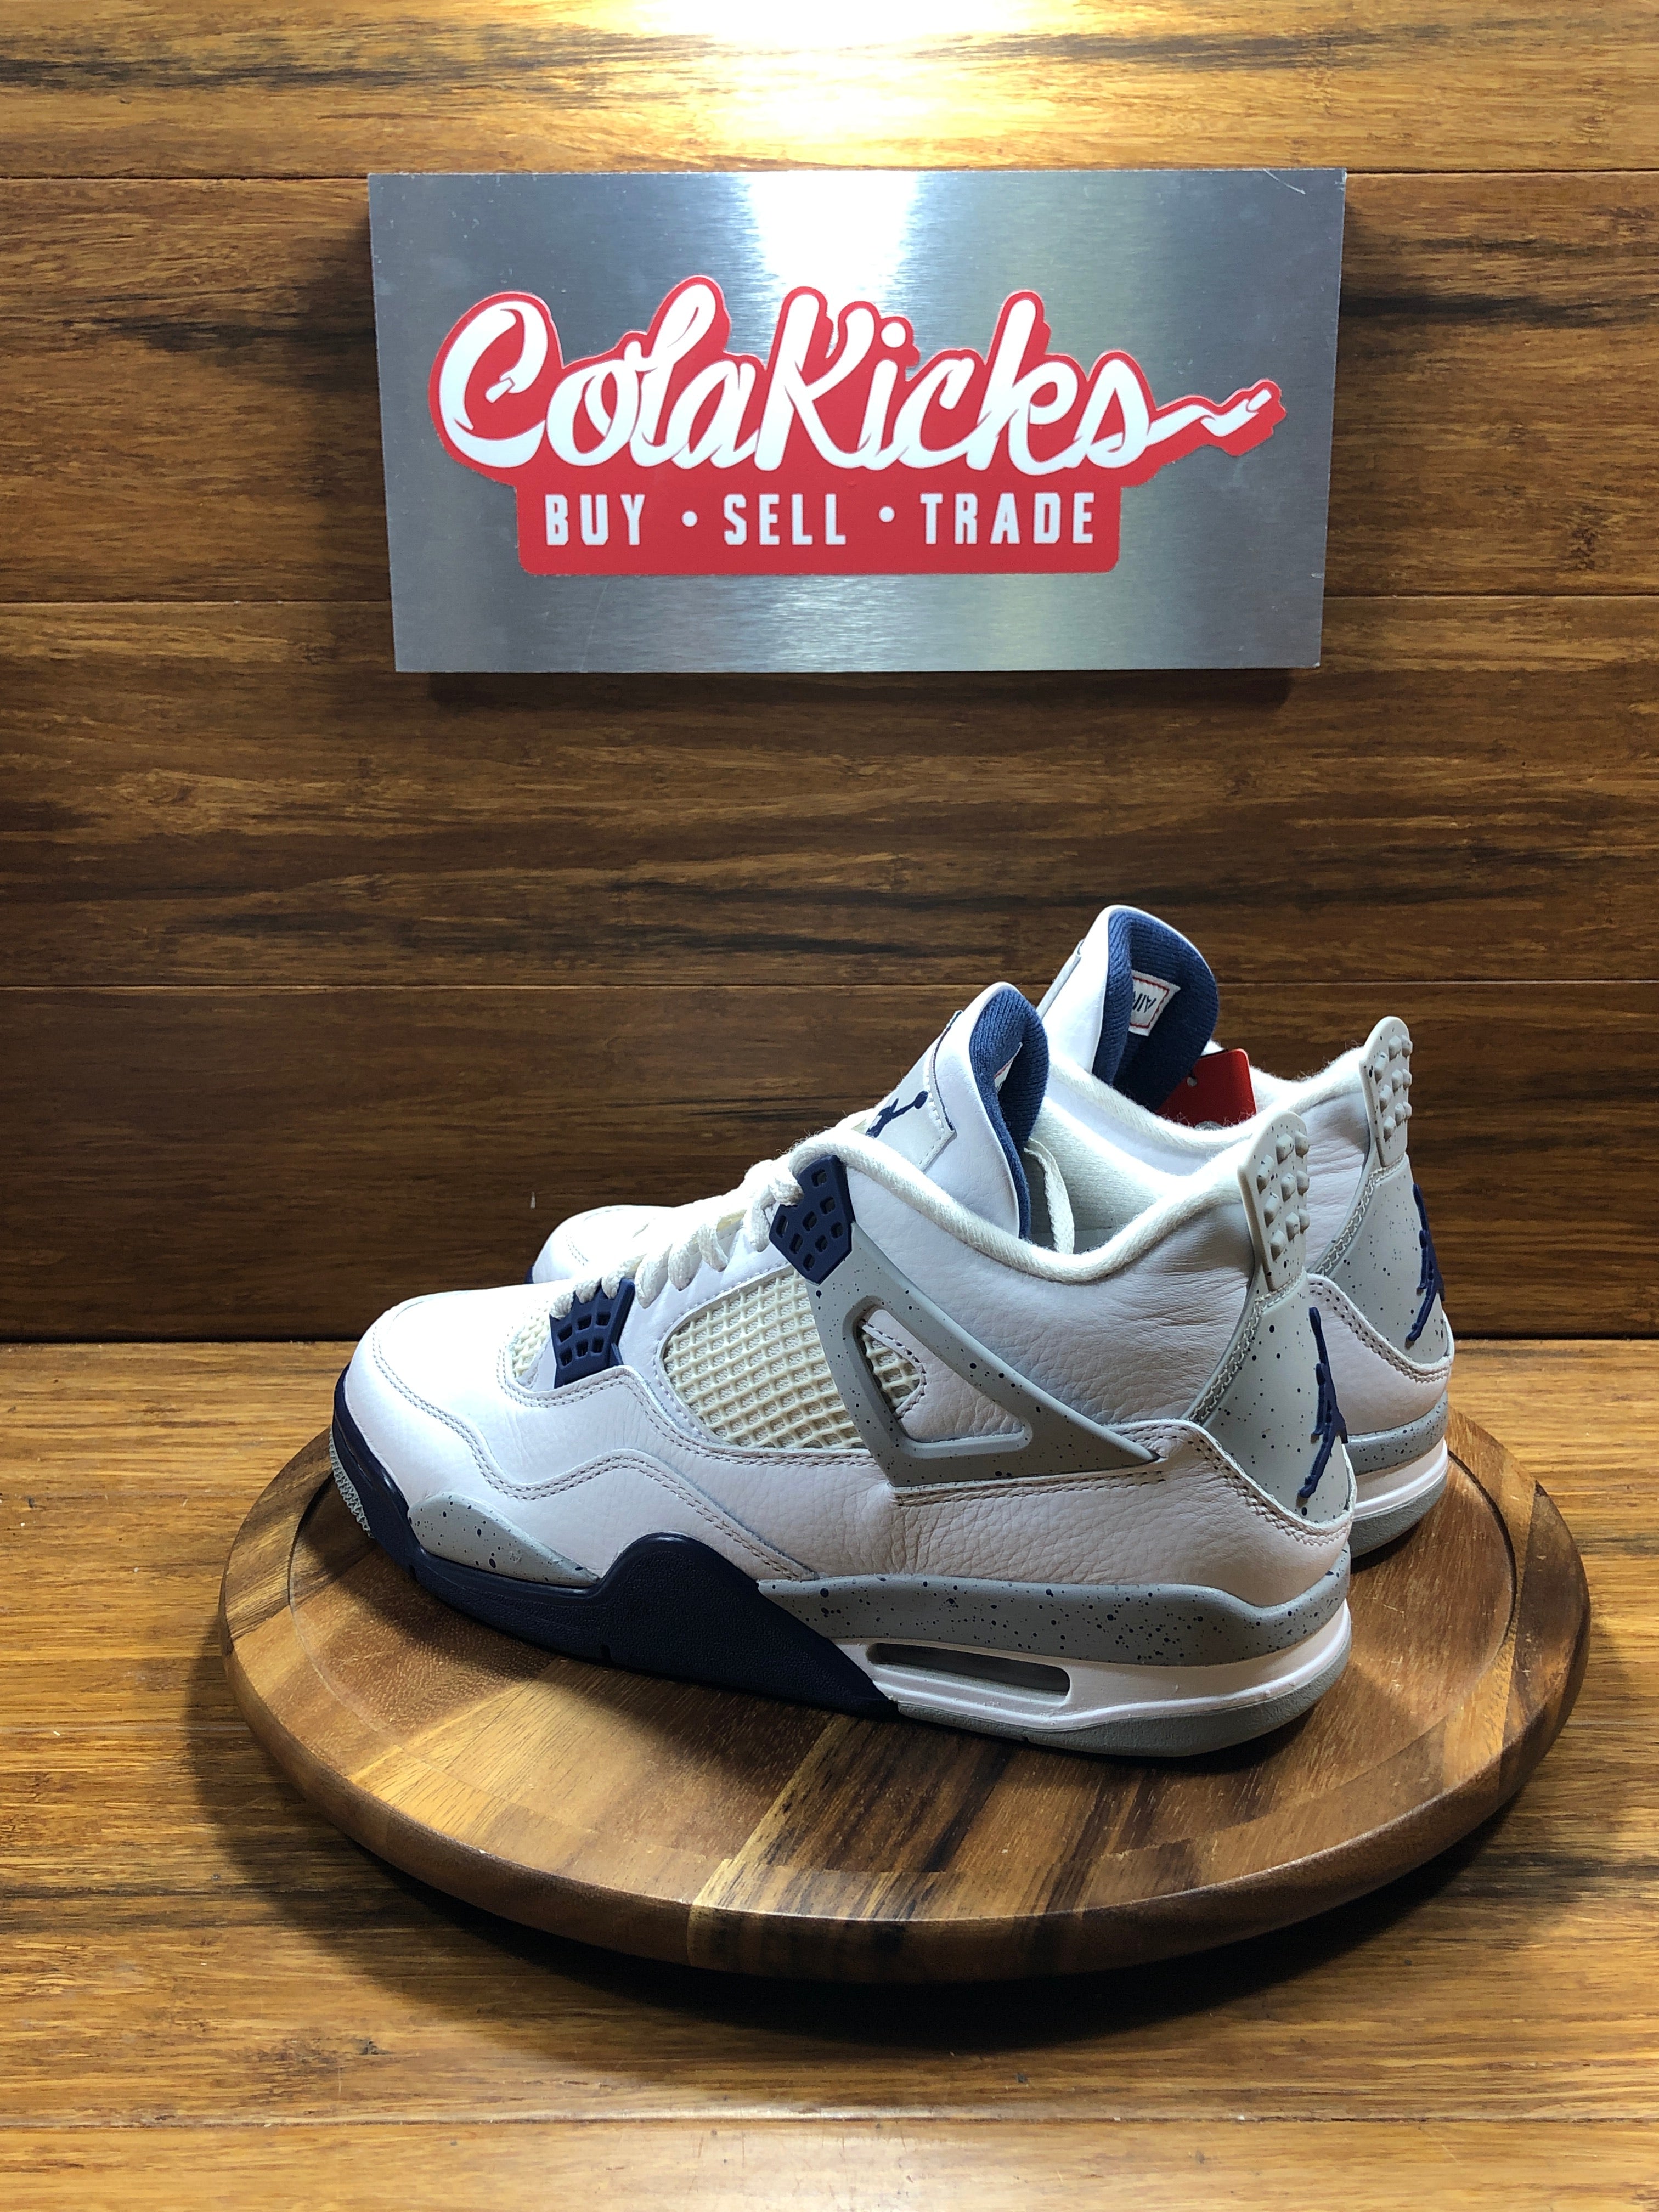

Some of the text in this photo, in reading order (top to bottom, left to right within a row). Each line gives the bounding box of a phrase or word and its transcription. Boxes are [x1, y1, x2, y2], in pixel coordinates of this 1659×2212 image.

[545, 493, 1094, 545] BUY SELL TRADE
